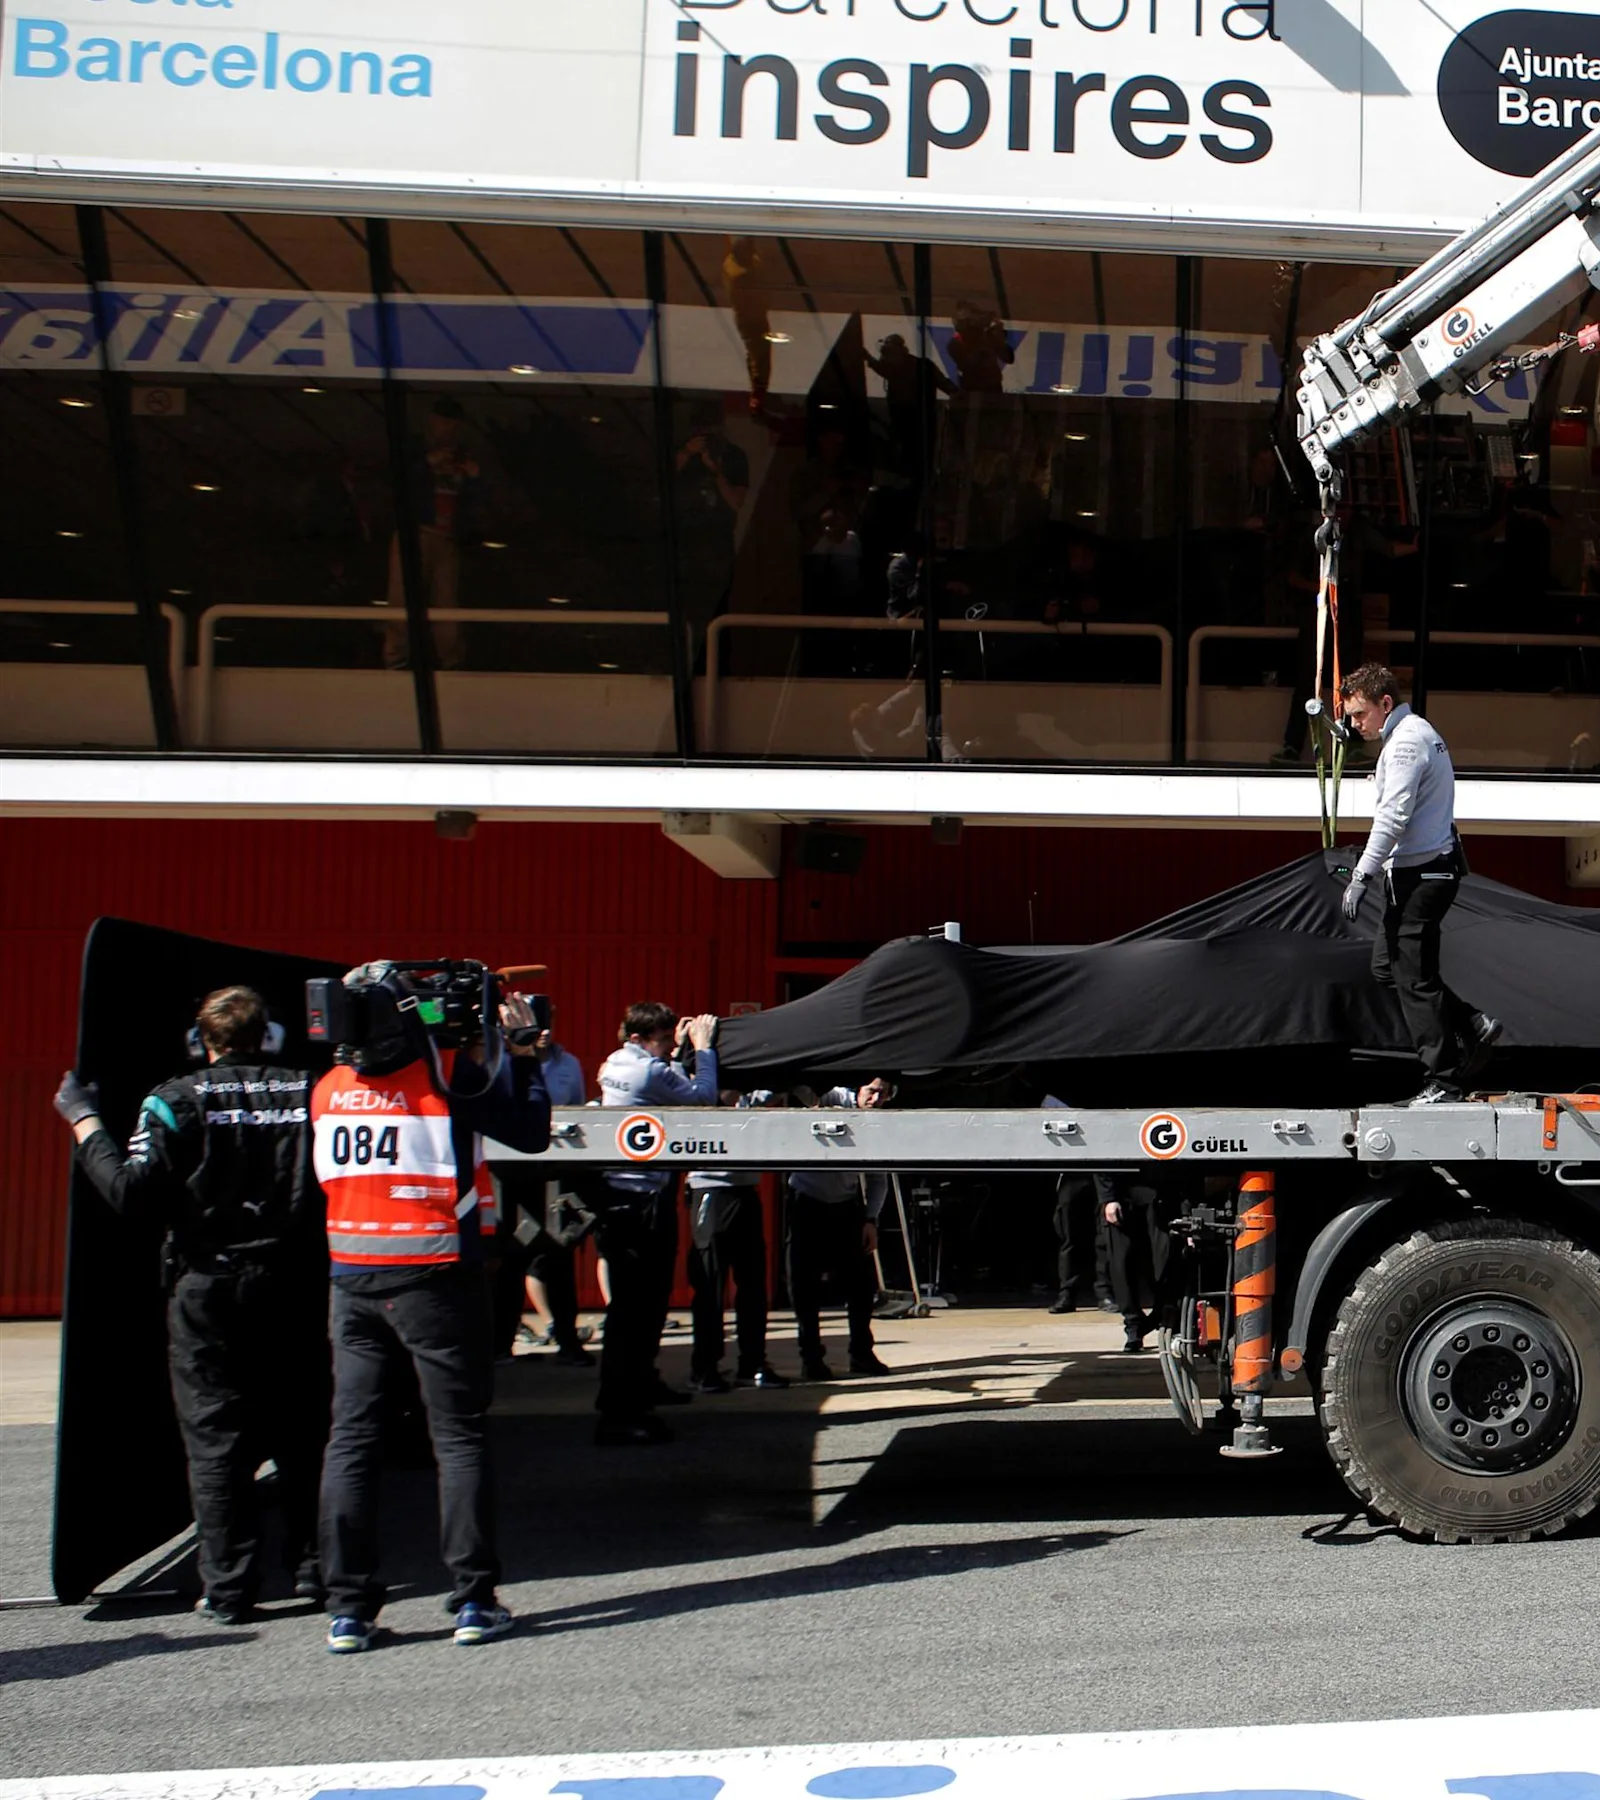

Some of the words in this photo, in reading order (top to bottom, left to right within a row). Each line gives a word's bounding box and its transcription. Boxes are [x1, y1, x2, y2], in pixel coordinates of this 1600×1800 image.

[14, 17, 432, 98] Barcelona
[674, 21, 1273, 178] inspires
[1453, 323, 1493, 358] GÜELL
[329, 1089, 409, 1111] MEDIA
[333, 1125, 399, 1166] 084
[669, 1137, 727, 1154] GÜELL
[1191, 1136, 1248, 1153] GÜELL
